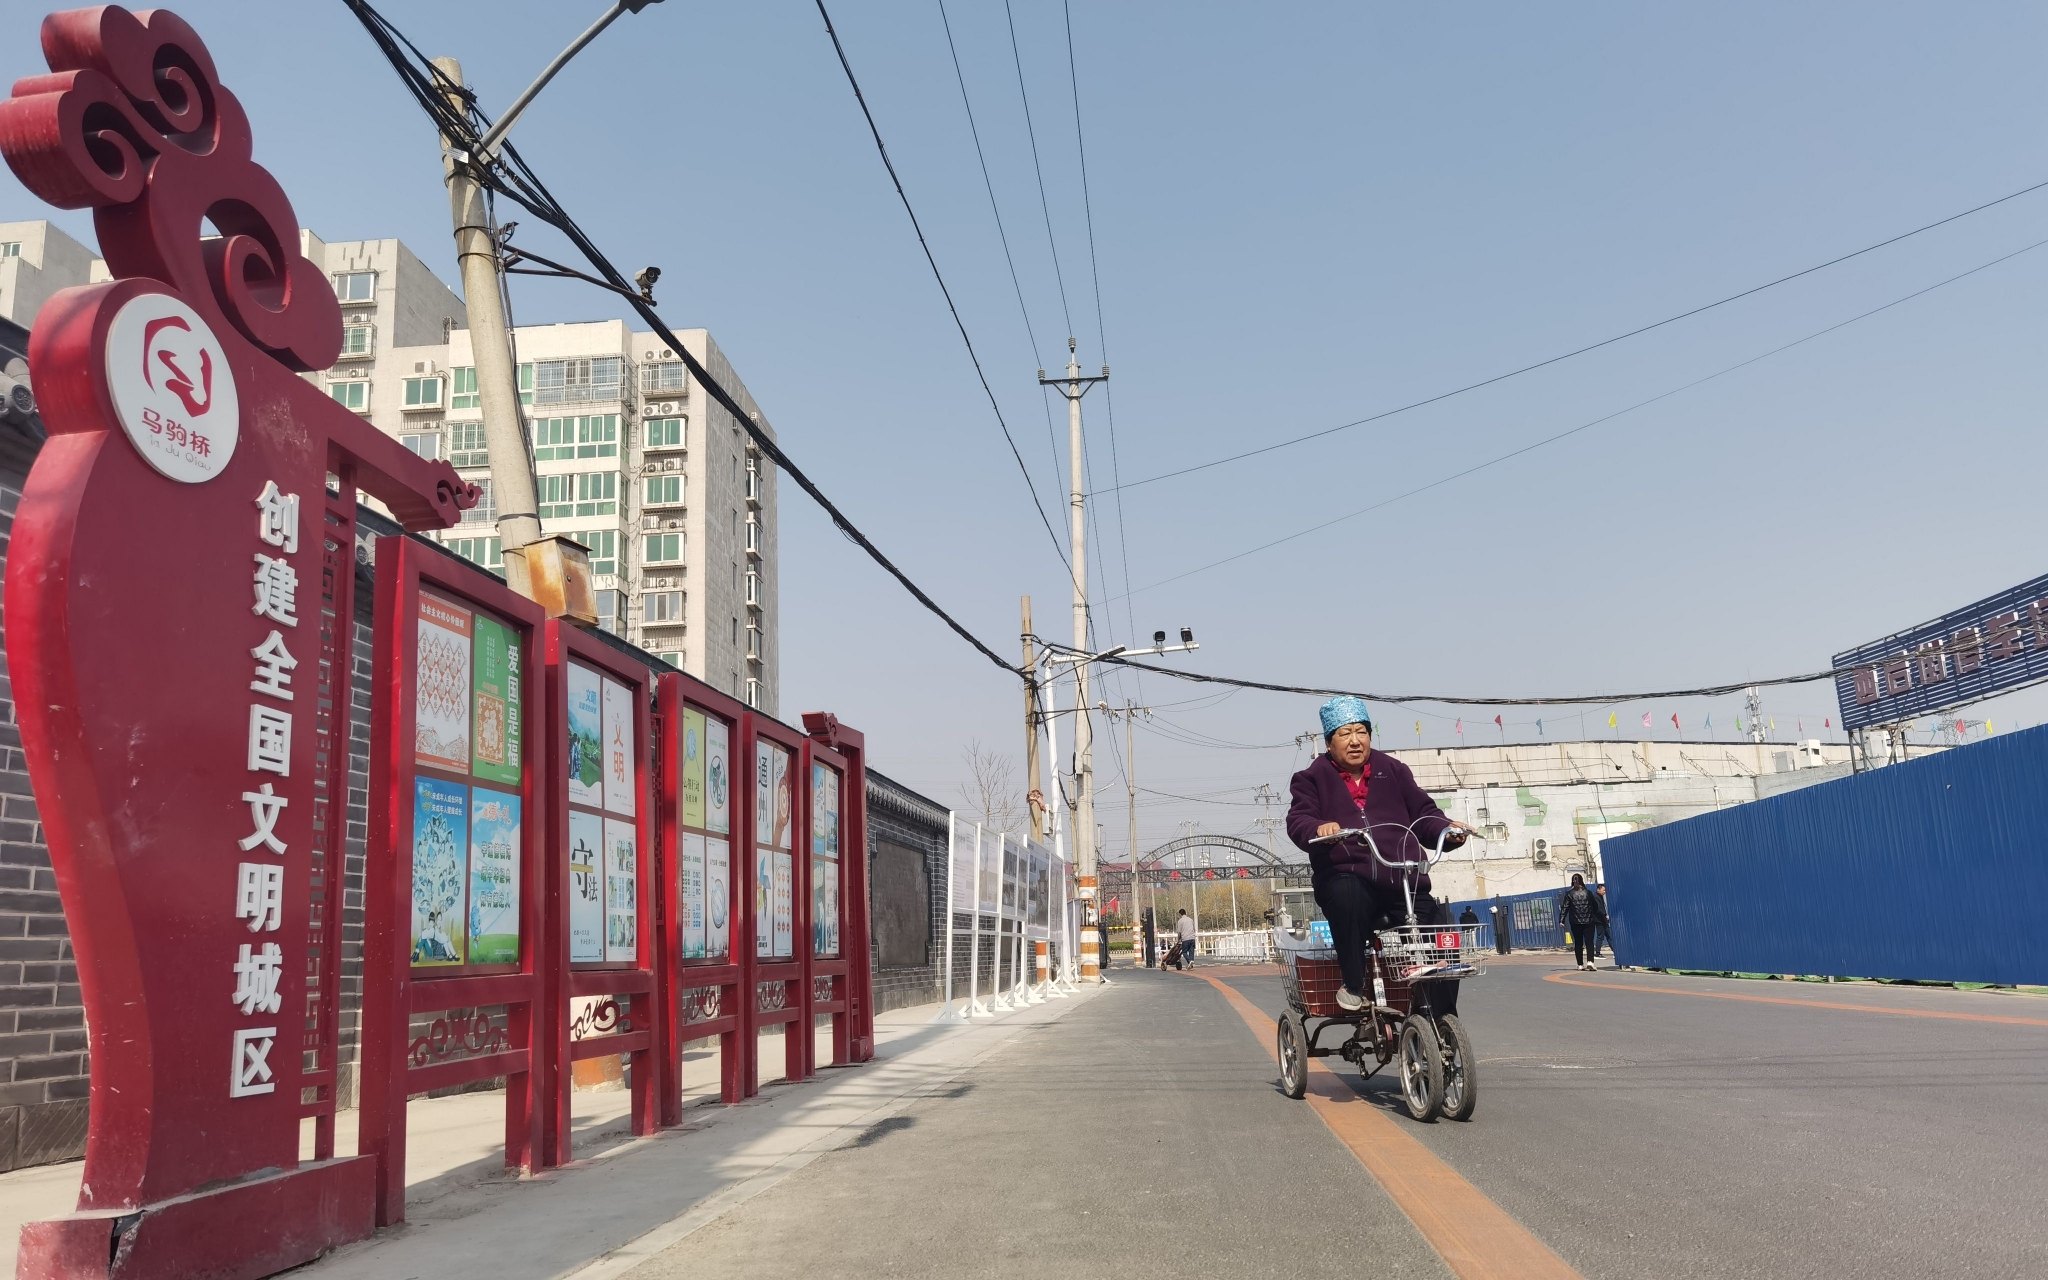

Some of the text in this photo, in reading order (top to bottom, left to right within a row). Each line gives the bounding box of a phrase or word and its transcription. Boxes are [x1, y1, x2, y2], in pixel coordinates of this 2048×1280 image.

[142, 406, 211, 458] 马驹桥
[165, 444, 180, 457] Ju
[421, 602, 465, 629] 社会主义核心价值观
[507, 644, 519, 768] 爱国是福
[585, 689, 597, 705] 文明
[613, 713, 625, 783] 文明
[230, 479, 301, 1099] 创建全国文明城区
[571, 838, 598, 902] 守法
